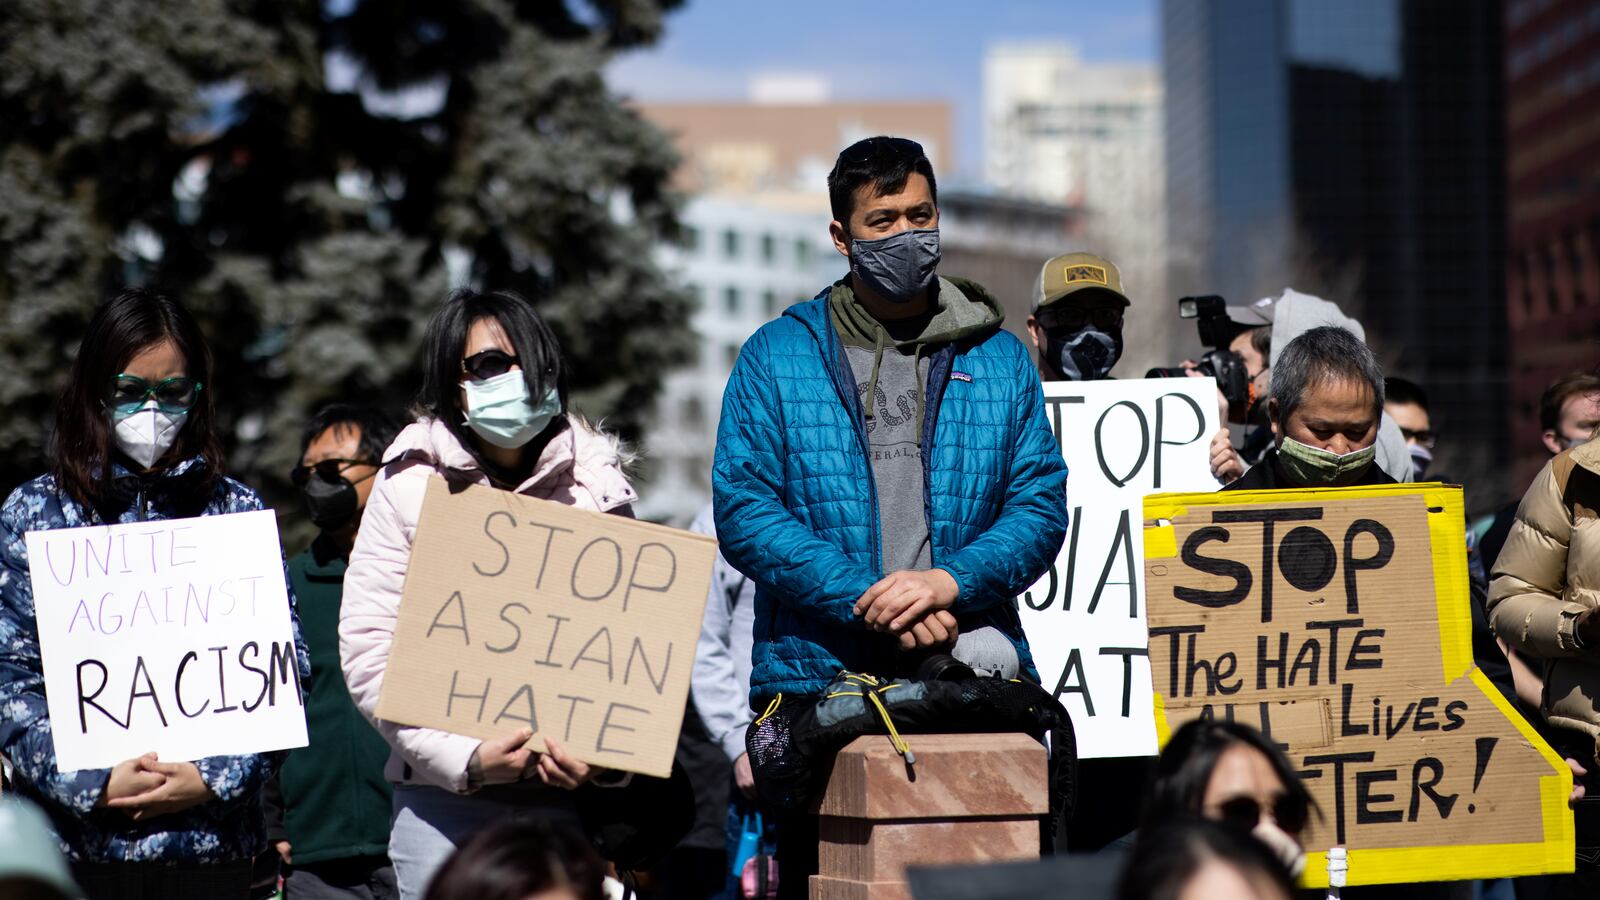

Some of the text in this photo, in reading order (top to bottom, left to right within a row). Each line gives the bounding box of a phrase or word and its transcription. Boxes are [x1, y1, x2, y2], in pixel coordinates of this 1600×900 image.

[869, 447, 914, 460] ERAL,
[1044, 392, 1206, 488] TOP
[46, 526, 197, 587] UNITE
[472, 511, 677, 612] STOP
[1173, 506, 1395, 622] STOP
[68, 576, 264, 635] AGAINST
[426, 591, 672, 695] ASIAN
[76, 641, 303, 733] RACISM
[1052, 647, 1149, 717] AT
[1149, 619, 1386, 698] The HATE
[446, 671, 651, 756] HATE
